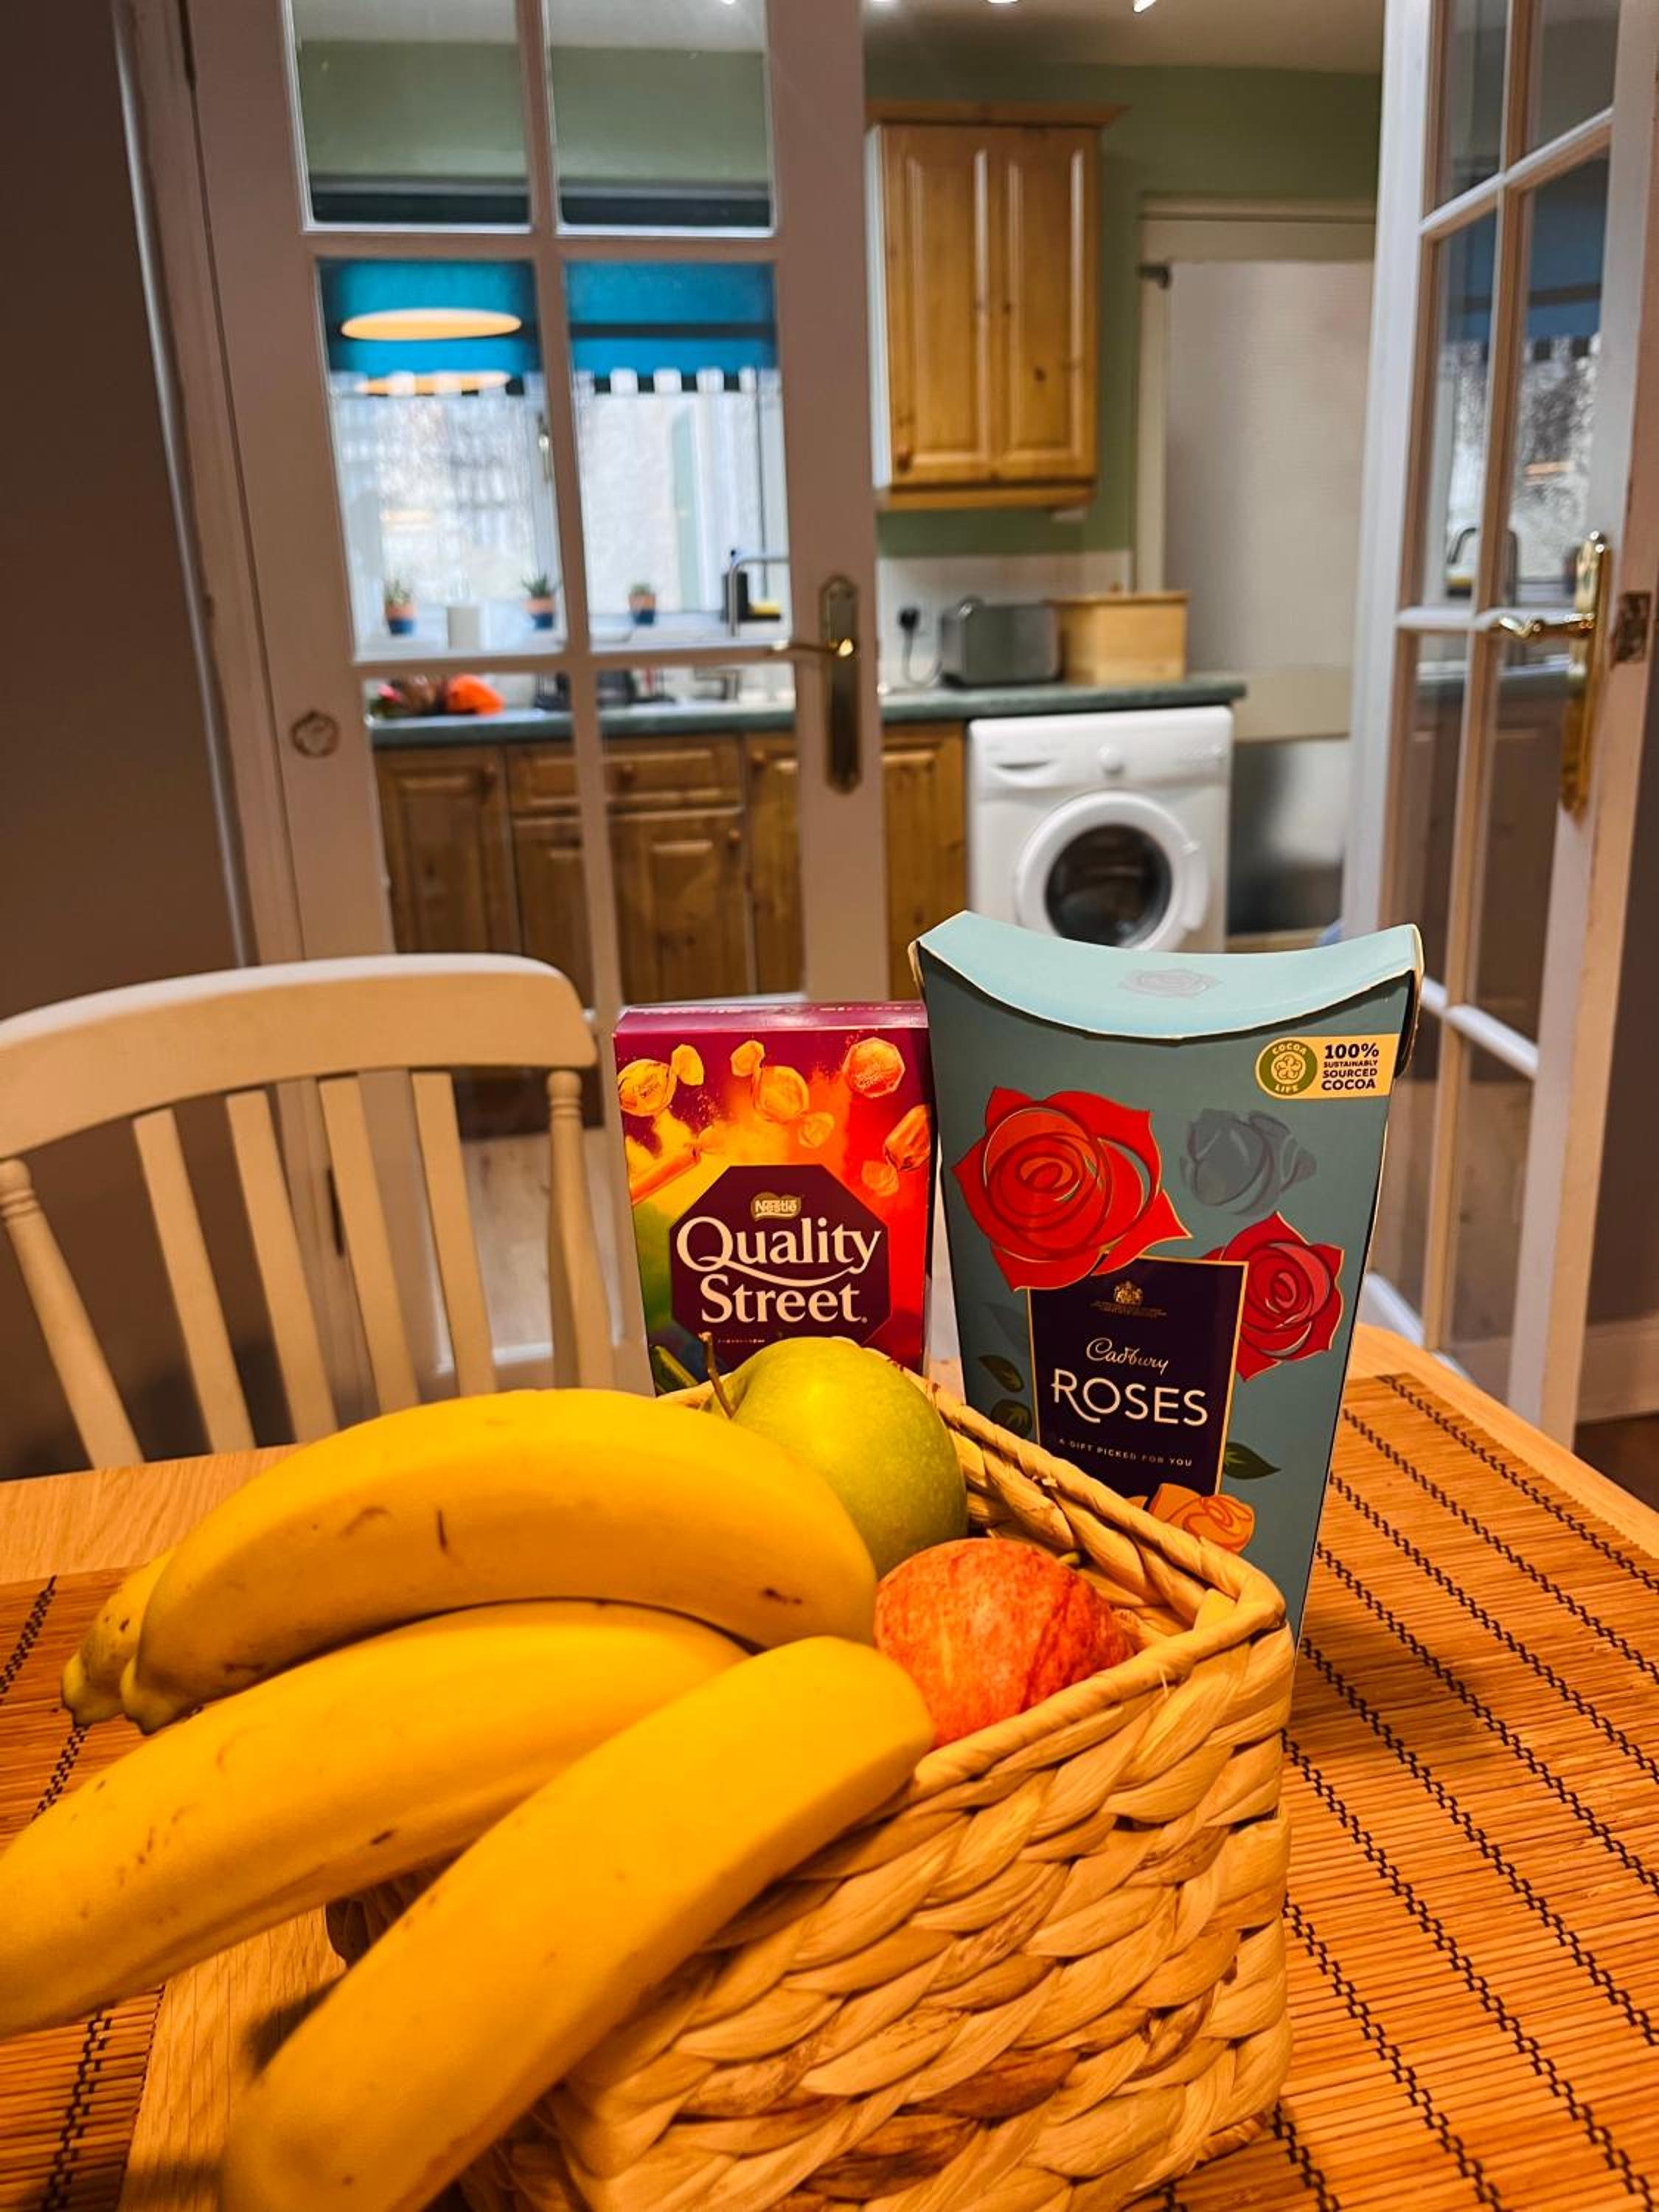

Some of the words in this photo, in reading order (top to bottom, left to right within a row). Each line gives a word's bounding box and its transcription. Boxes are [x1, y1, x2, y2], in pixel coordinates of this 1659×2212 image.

[1272, 1043, 1307, 1056] COCOA
[1325, 1043, 1380, 1059] 100%
[1324, 1060, 1378, 1068] SUSTAINABLY
[1322, 1068, 1378, 1079] SOURCED
[1275, 1083, 1299, 1093] LIFE
[1321, 1079, 1377, 1091] COCOA
[676, 1217, 882, 1287] Quality
[1085, 1337, 1169, 1376] Cadbury
[1050, 1368, 1208, 1427] ROSES
[1069, 1440, 1093, 1452] GIFT
[1096, 1447, 1137, 1460] PICKED
[1141, 1455, 1164, 1464] FOR
[1169, 1458, 1192, 1467] YOU
